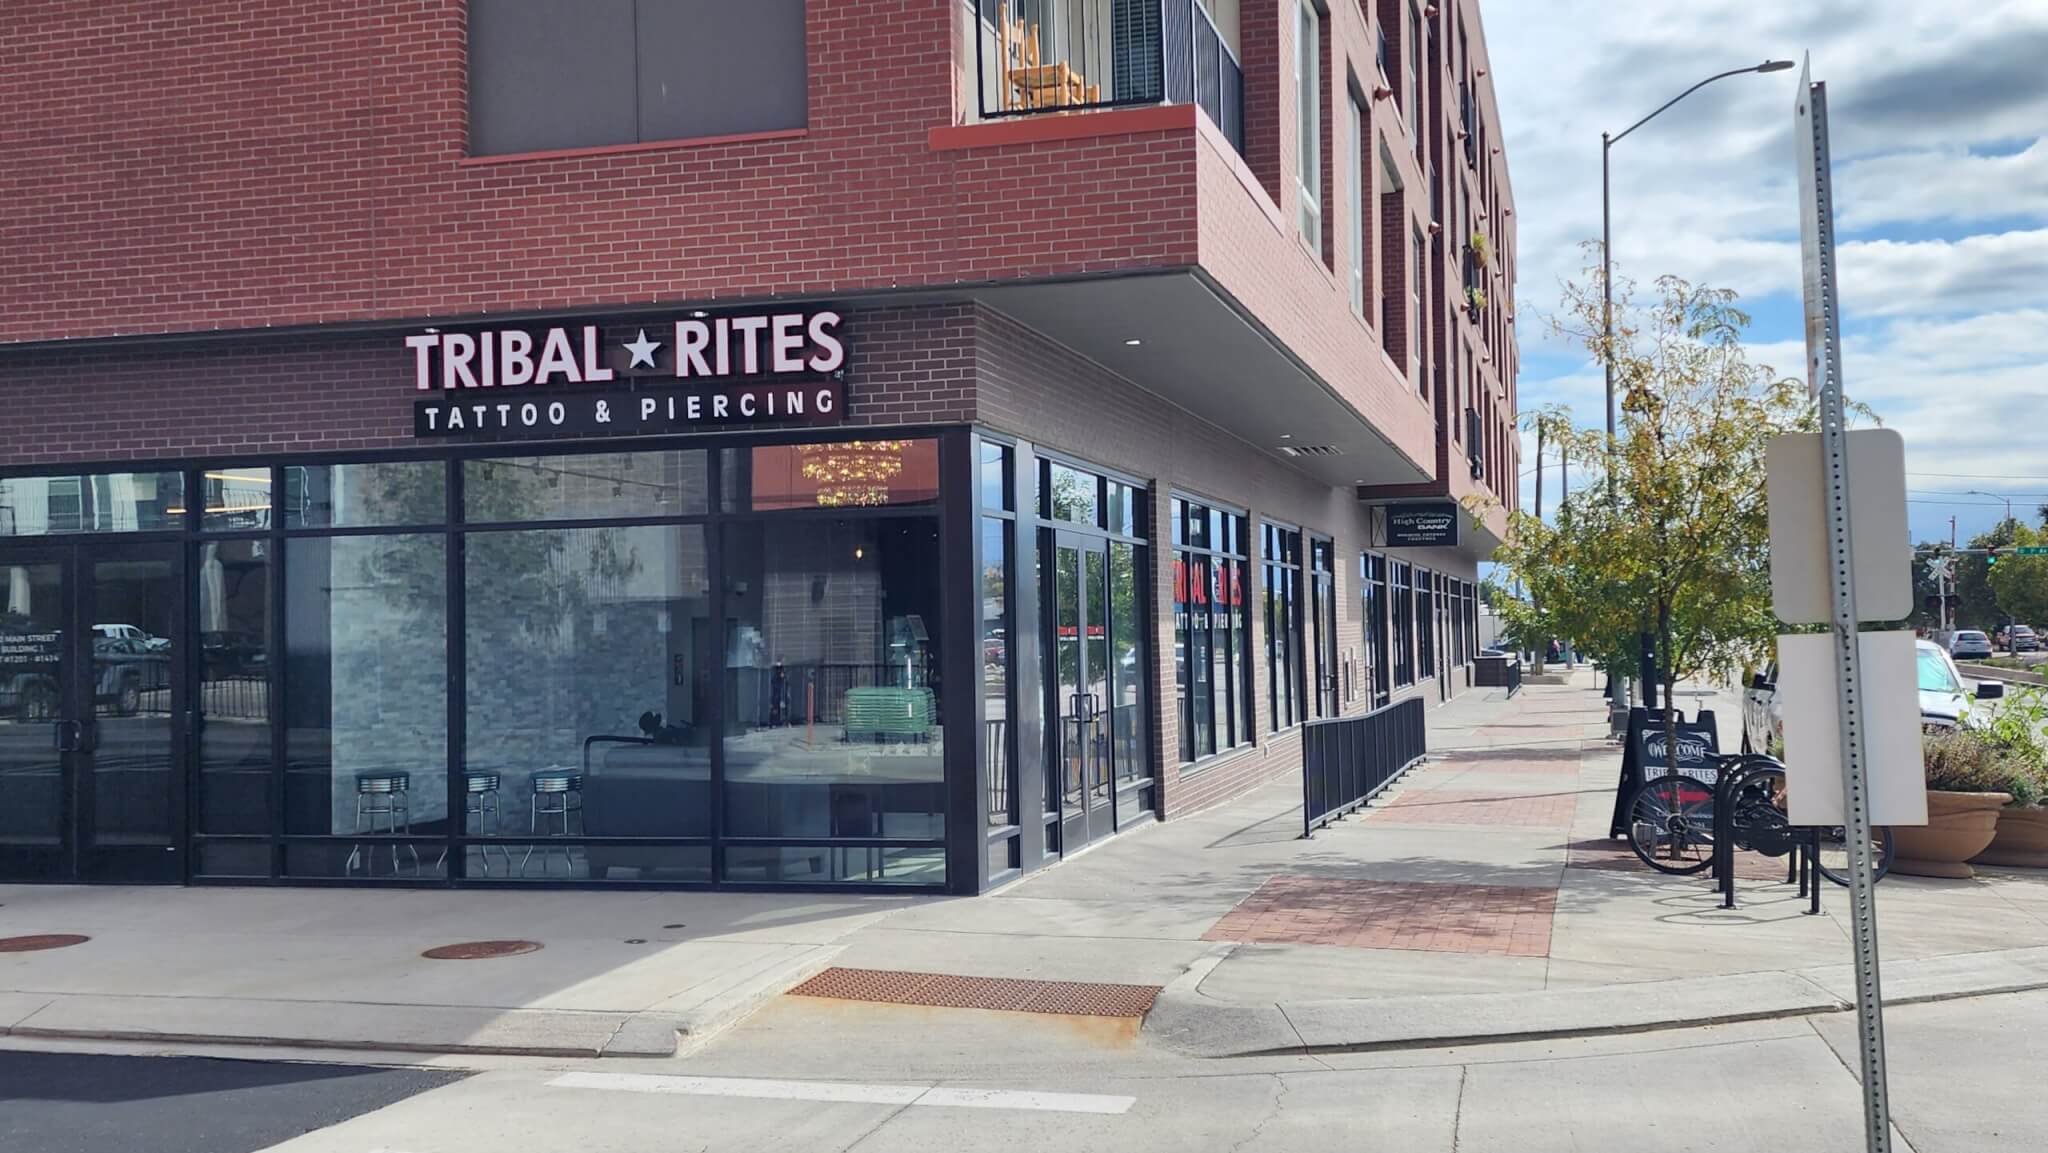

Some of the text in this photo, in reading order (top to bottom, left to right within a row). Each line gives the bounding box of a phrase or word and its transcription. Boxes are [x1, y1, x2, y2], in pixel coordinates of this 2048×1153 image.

[405, 311, 845, 390] TRIBAL RITES
[425, 389, 834, 430] TATTOO & PIERCING
[1393, 517, 1451, 526] High Country
[27, 634, 57, 642] STREET
[1648, 743, 1706, 758] WECOME
